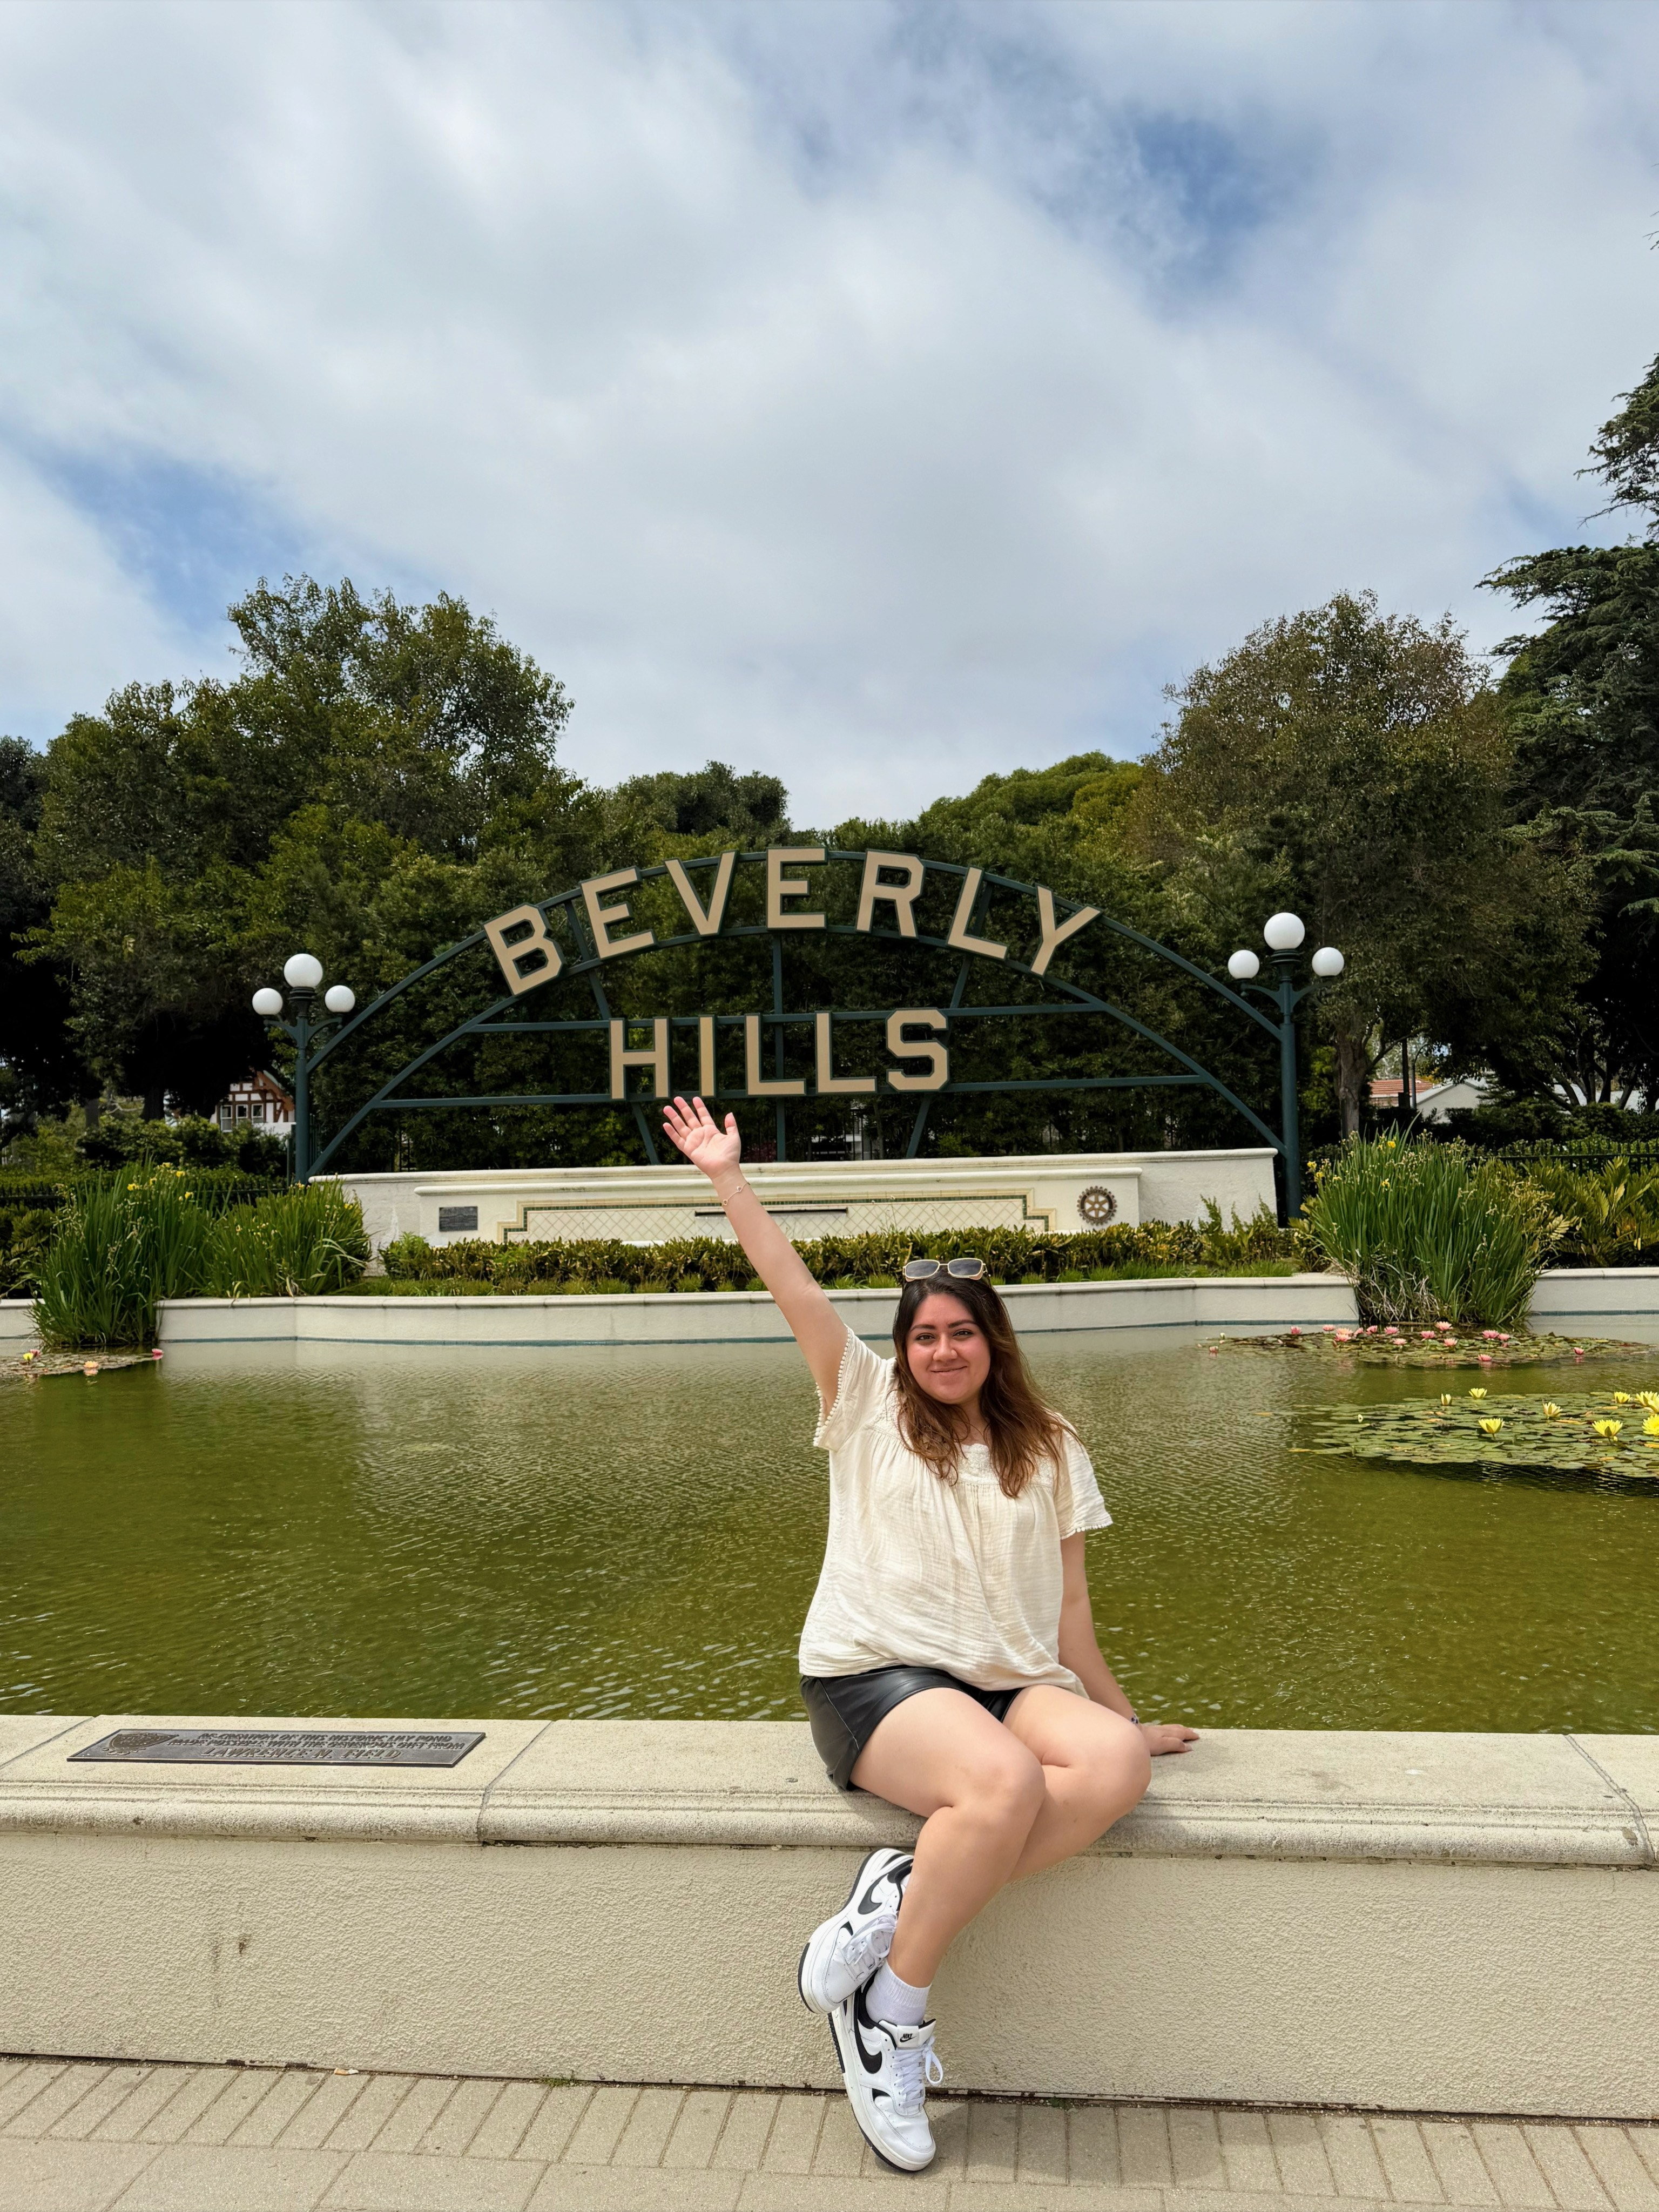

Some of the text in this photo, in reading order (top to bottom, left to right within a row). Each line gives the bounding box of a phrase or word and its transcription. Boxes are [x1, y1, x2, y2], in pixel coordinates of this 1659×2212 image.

[484, 847, 1101, 996] BEVERLY
[609, 1008, 949, 1100] HILLS
[201, 1748, 401, 1759] LAWRENCE N. FIELD
